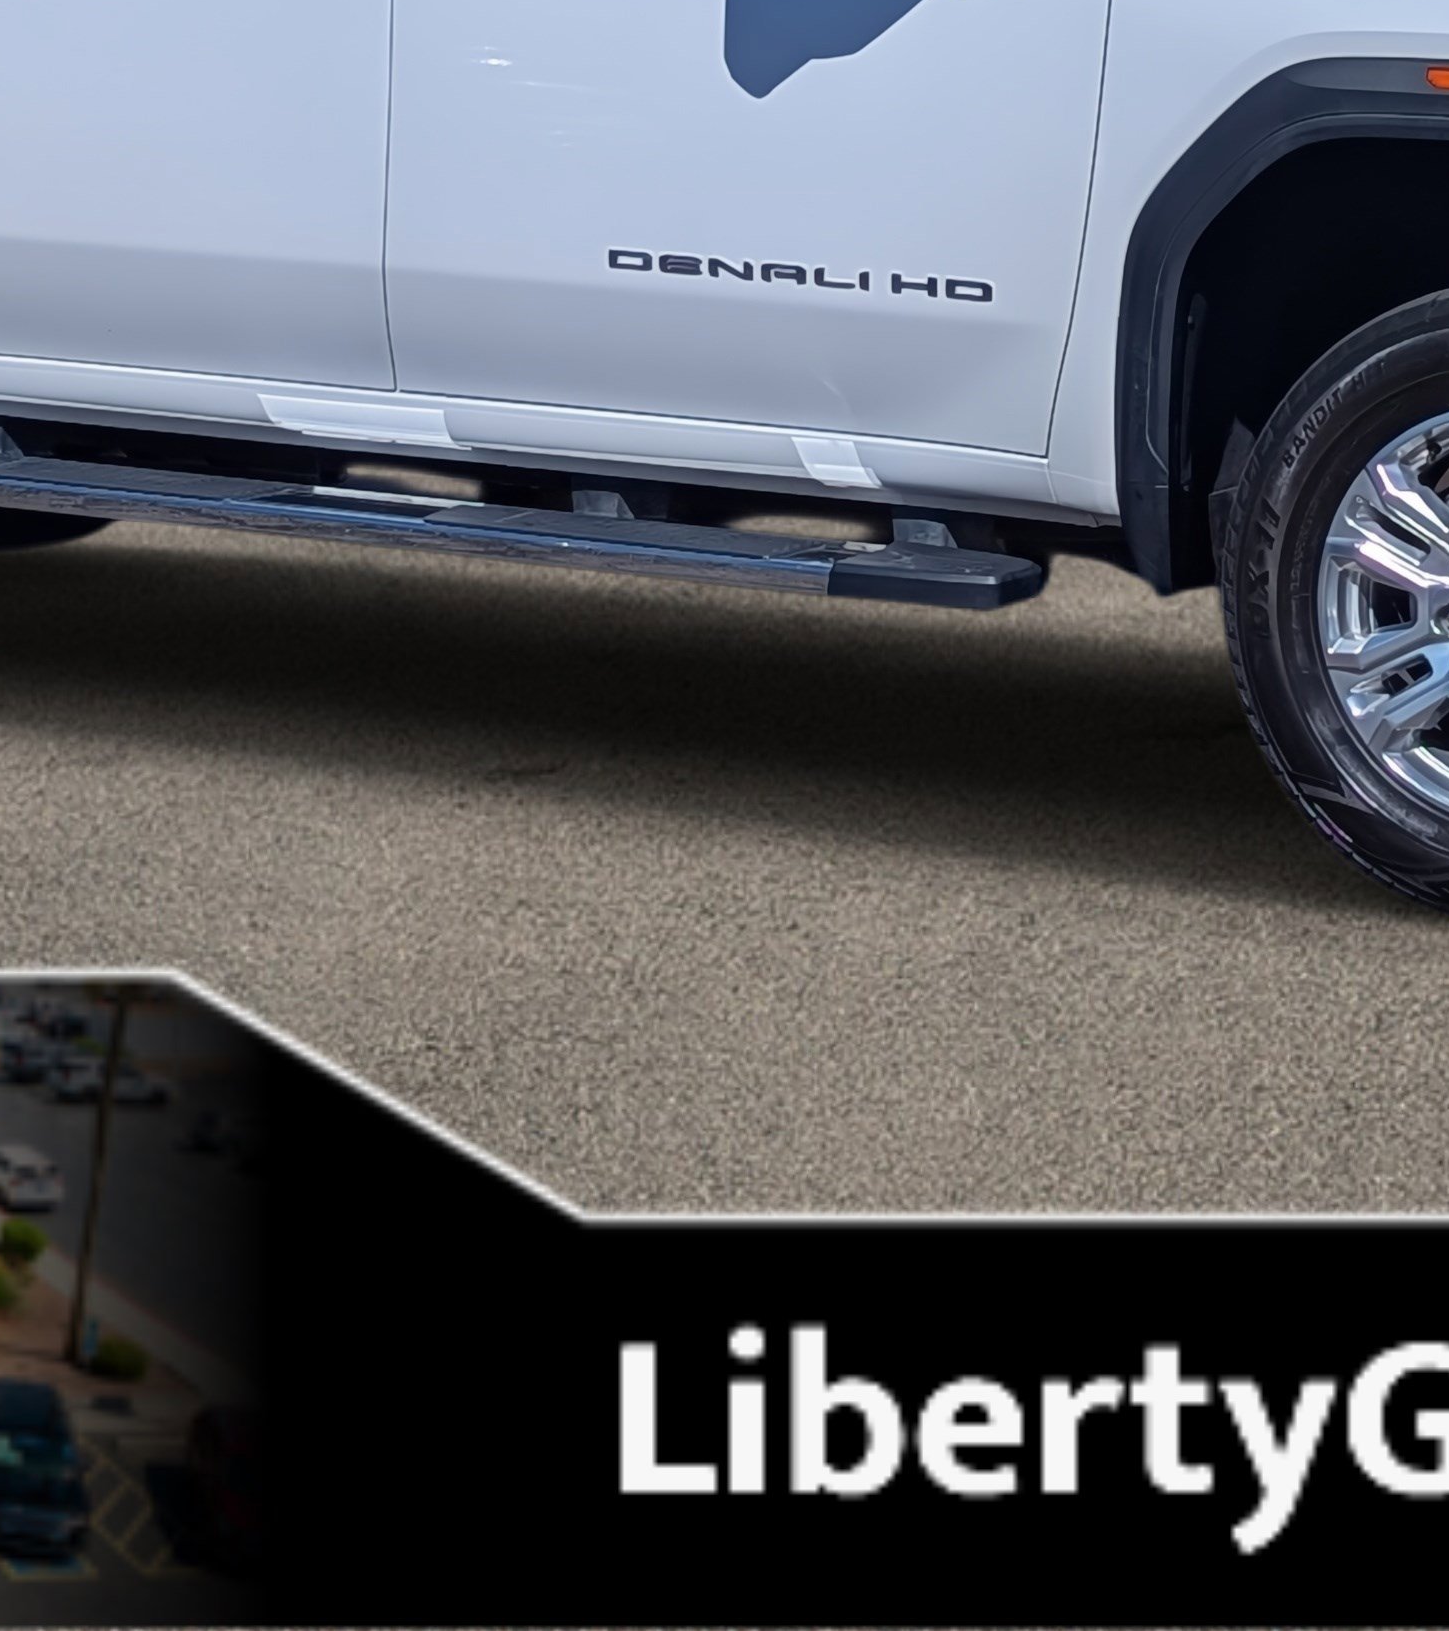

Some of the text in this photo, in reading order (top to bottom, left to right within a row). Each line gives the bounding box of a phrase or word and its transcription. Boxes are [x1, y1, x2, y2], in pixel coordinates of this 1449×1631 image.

[608, 249, 993, 303] DENALI HD
[1280, 387, 1345, 469] BANDIT
